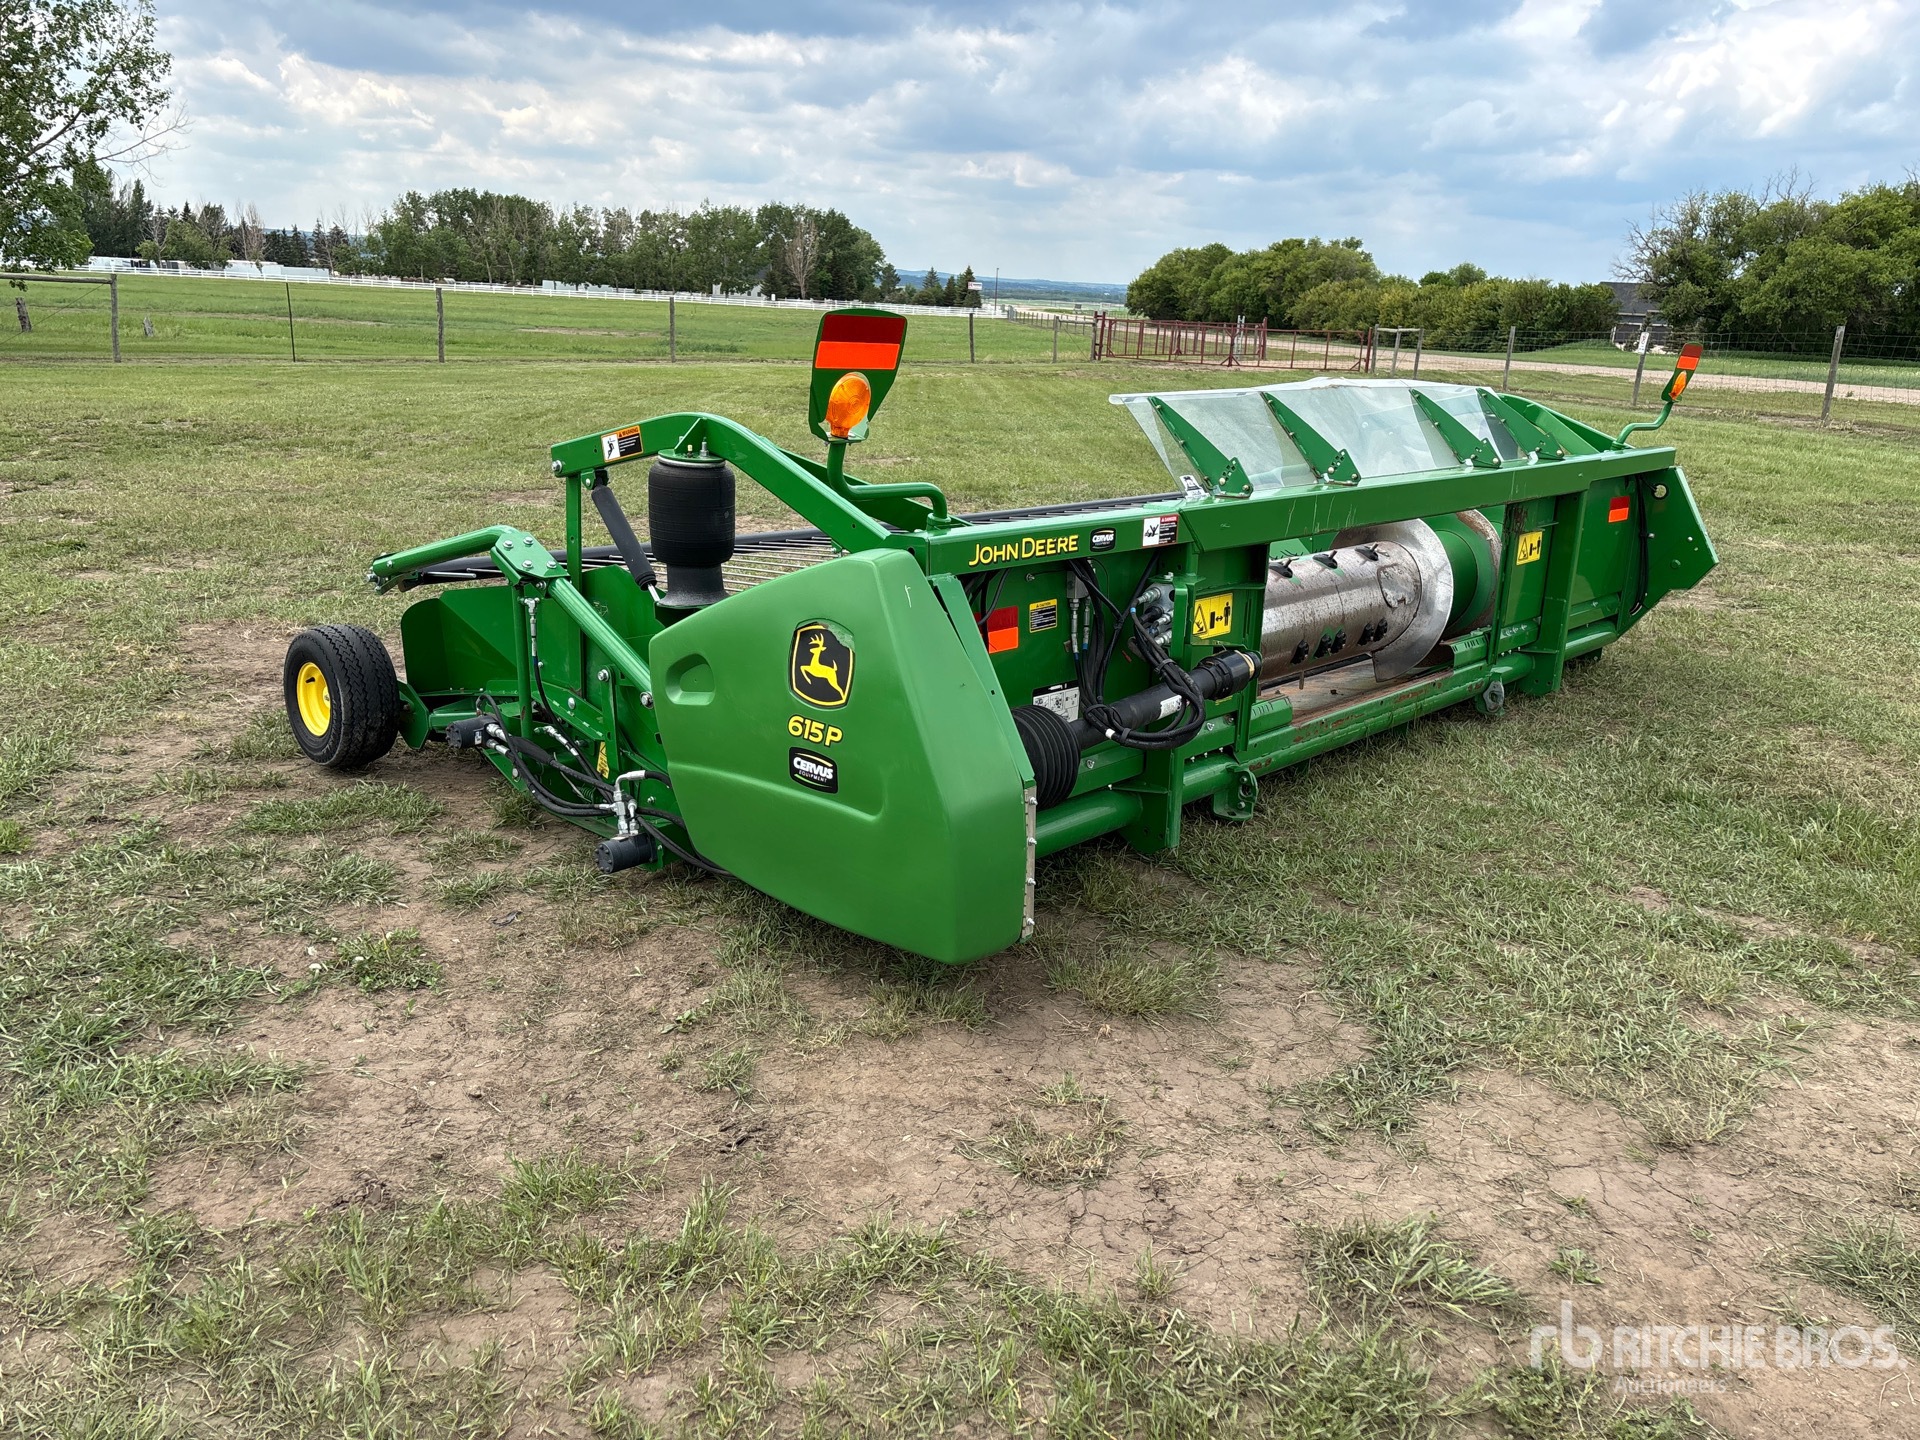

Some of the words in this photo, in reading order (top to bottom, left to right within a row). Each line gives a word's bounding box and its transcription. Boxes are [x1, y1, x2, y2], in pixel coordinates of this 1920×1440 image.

[968, 543, 1019, 566] JOHN
[1021, 534, 1079, 558] DEERE
[1092, 533, 1115, 544] CERVUS
[788, 715, 843, 747] 615P
[793, 756, 834, 780] CERVUS
[798, 770, 828, 783] EQUIPMENT
